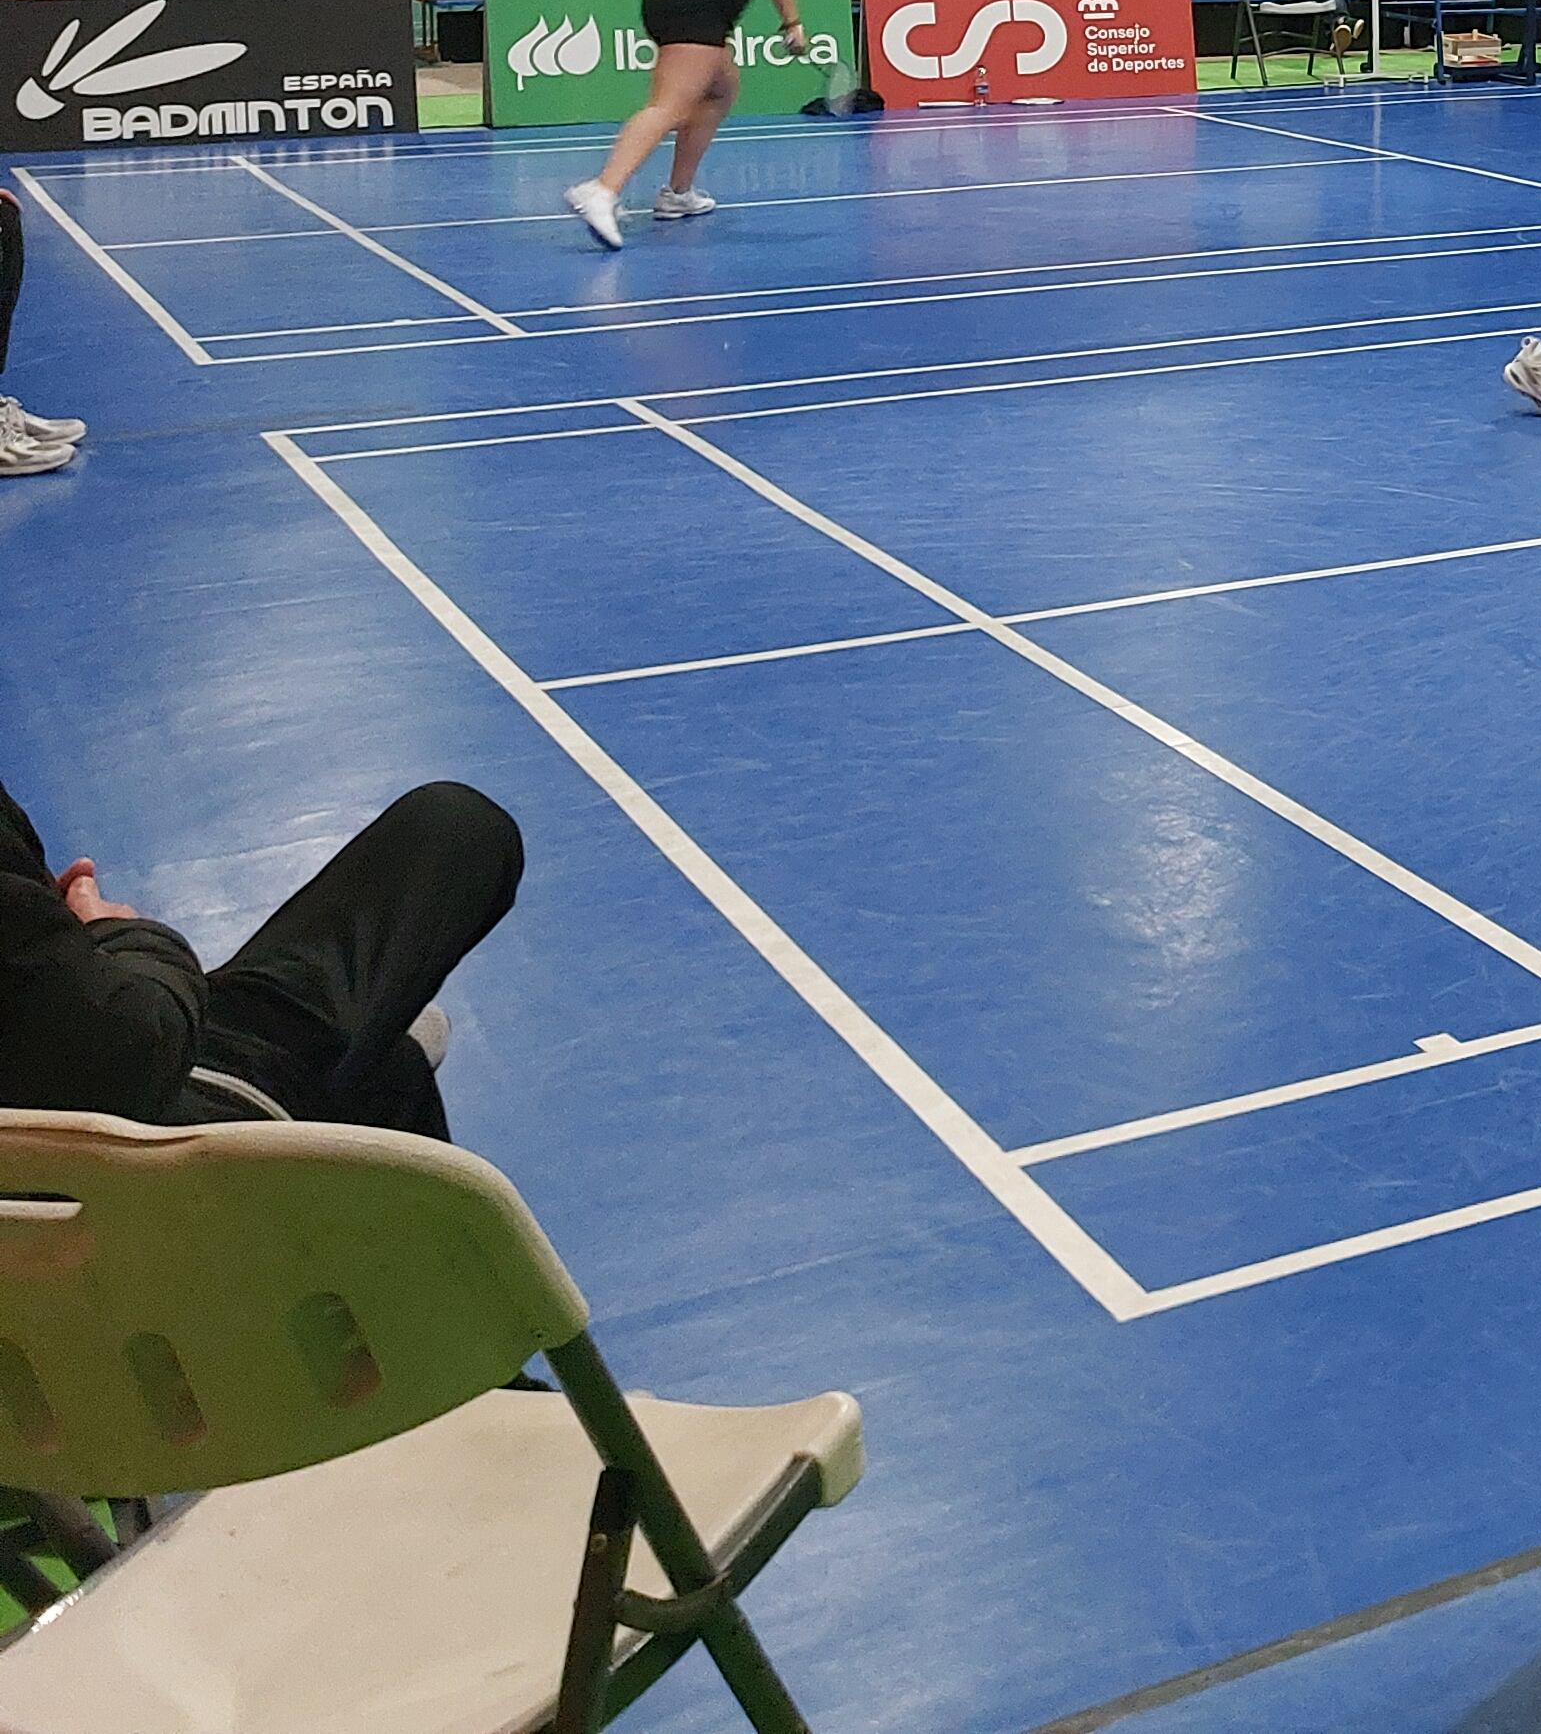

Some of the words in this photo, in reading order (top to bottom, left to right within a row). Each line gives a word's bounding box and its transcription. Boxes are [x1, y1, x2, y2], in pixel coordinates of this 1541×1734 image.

[1084, 24, 1150, 42] Consejo
[1086, 41, 1156, 58] Superior
[1087, 58, 1107, 73] de
[1112, 57, 1185, 74] Deportes
[283, 69, 393, 91] ESPAÑA
[82, 96, 395, 141] BADMINTON
